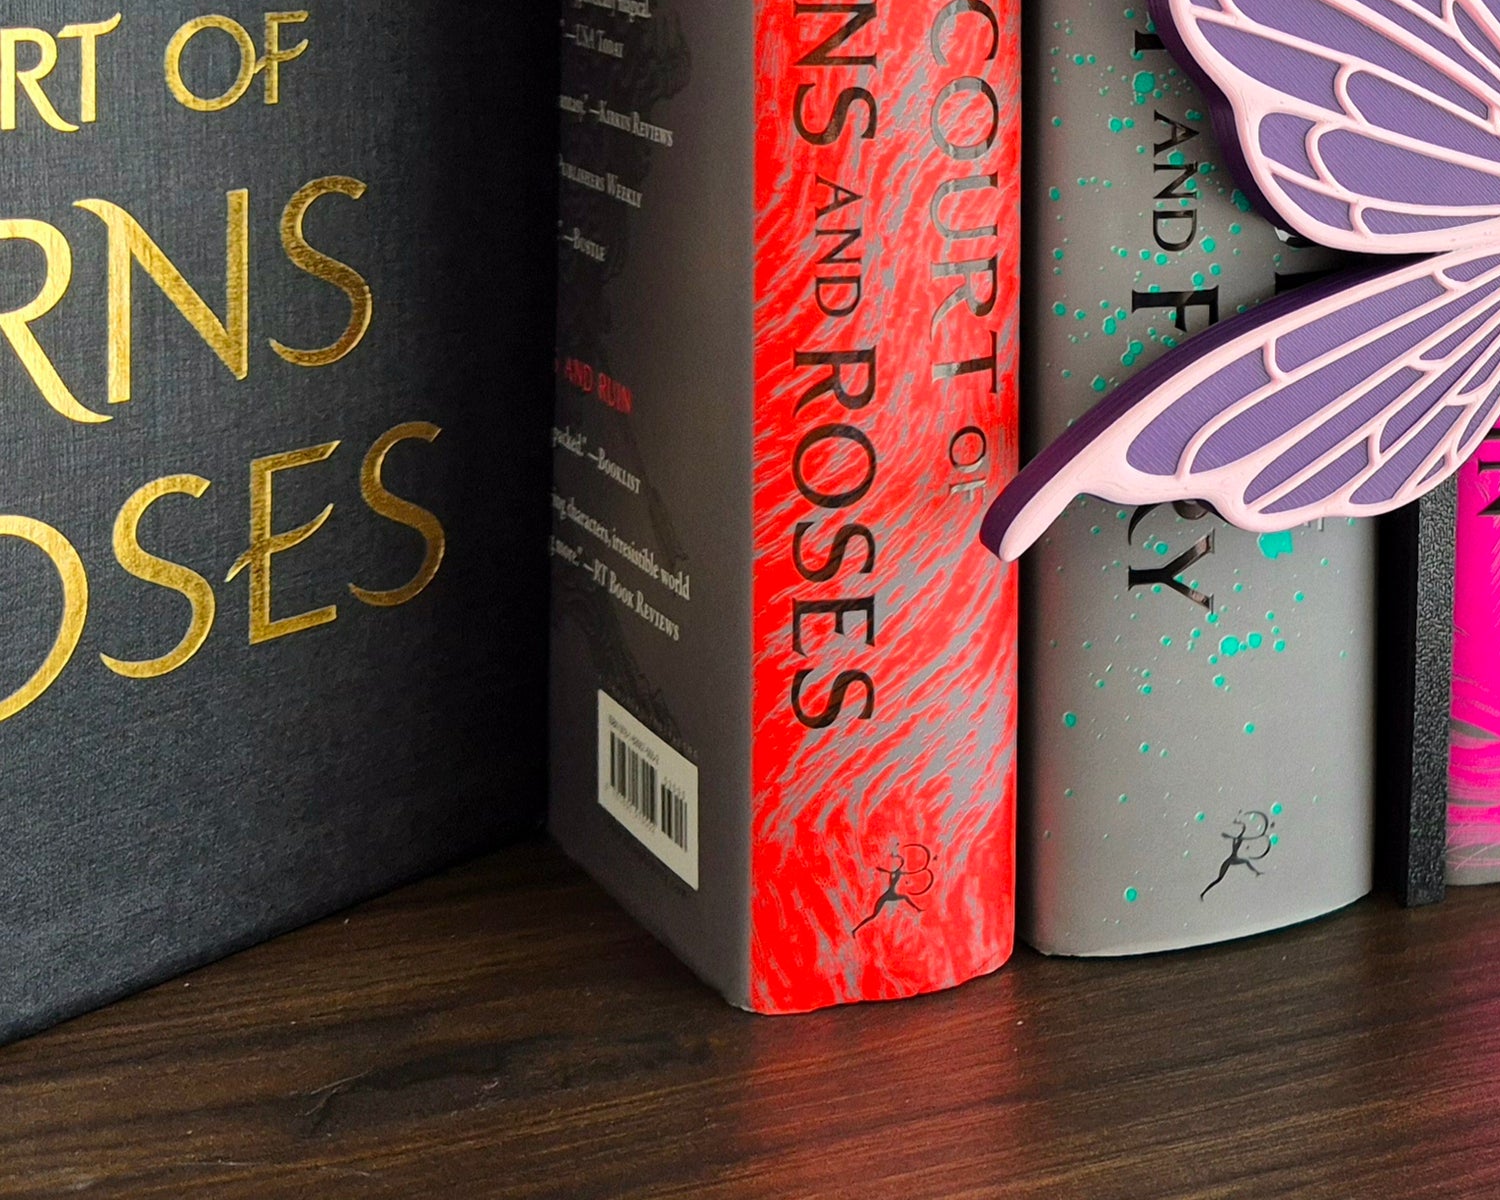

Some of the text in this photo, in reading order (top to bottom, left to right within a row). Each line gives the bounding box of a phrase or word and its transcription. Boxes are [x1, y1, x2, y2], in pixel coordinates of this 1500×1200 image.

[164, 9, 310, 112] OF
[631, 111, 674, 148] REVIEWS
[606, 172, 643, 208] WEEKLY
[1152, 108, 1200, 254] AND
[815, 174, 865, 319] AND
[0, 174, 373, 424] RNS
[564, 356, 634, 415] AND RUIN
[948, 424, 988, 502] OF
[612, 527, 660, 579] irresistible
[660, 570, 691, 601] world
[790, 344, 878, 731] ROSES
[609, 569, 635, 610] BOOK
[635, 589, 680, 642] REVIEWS
